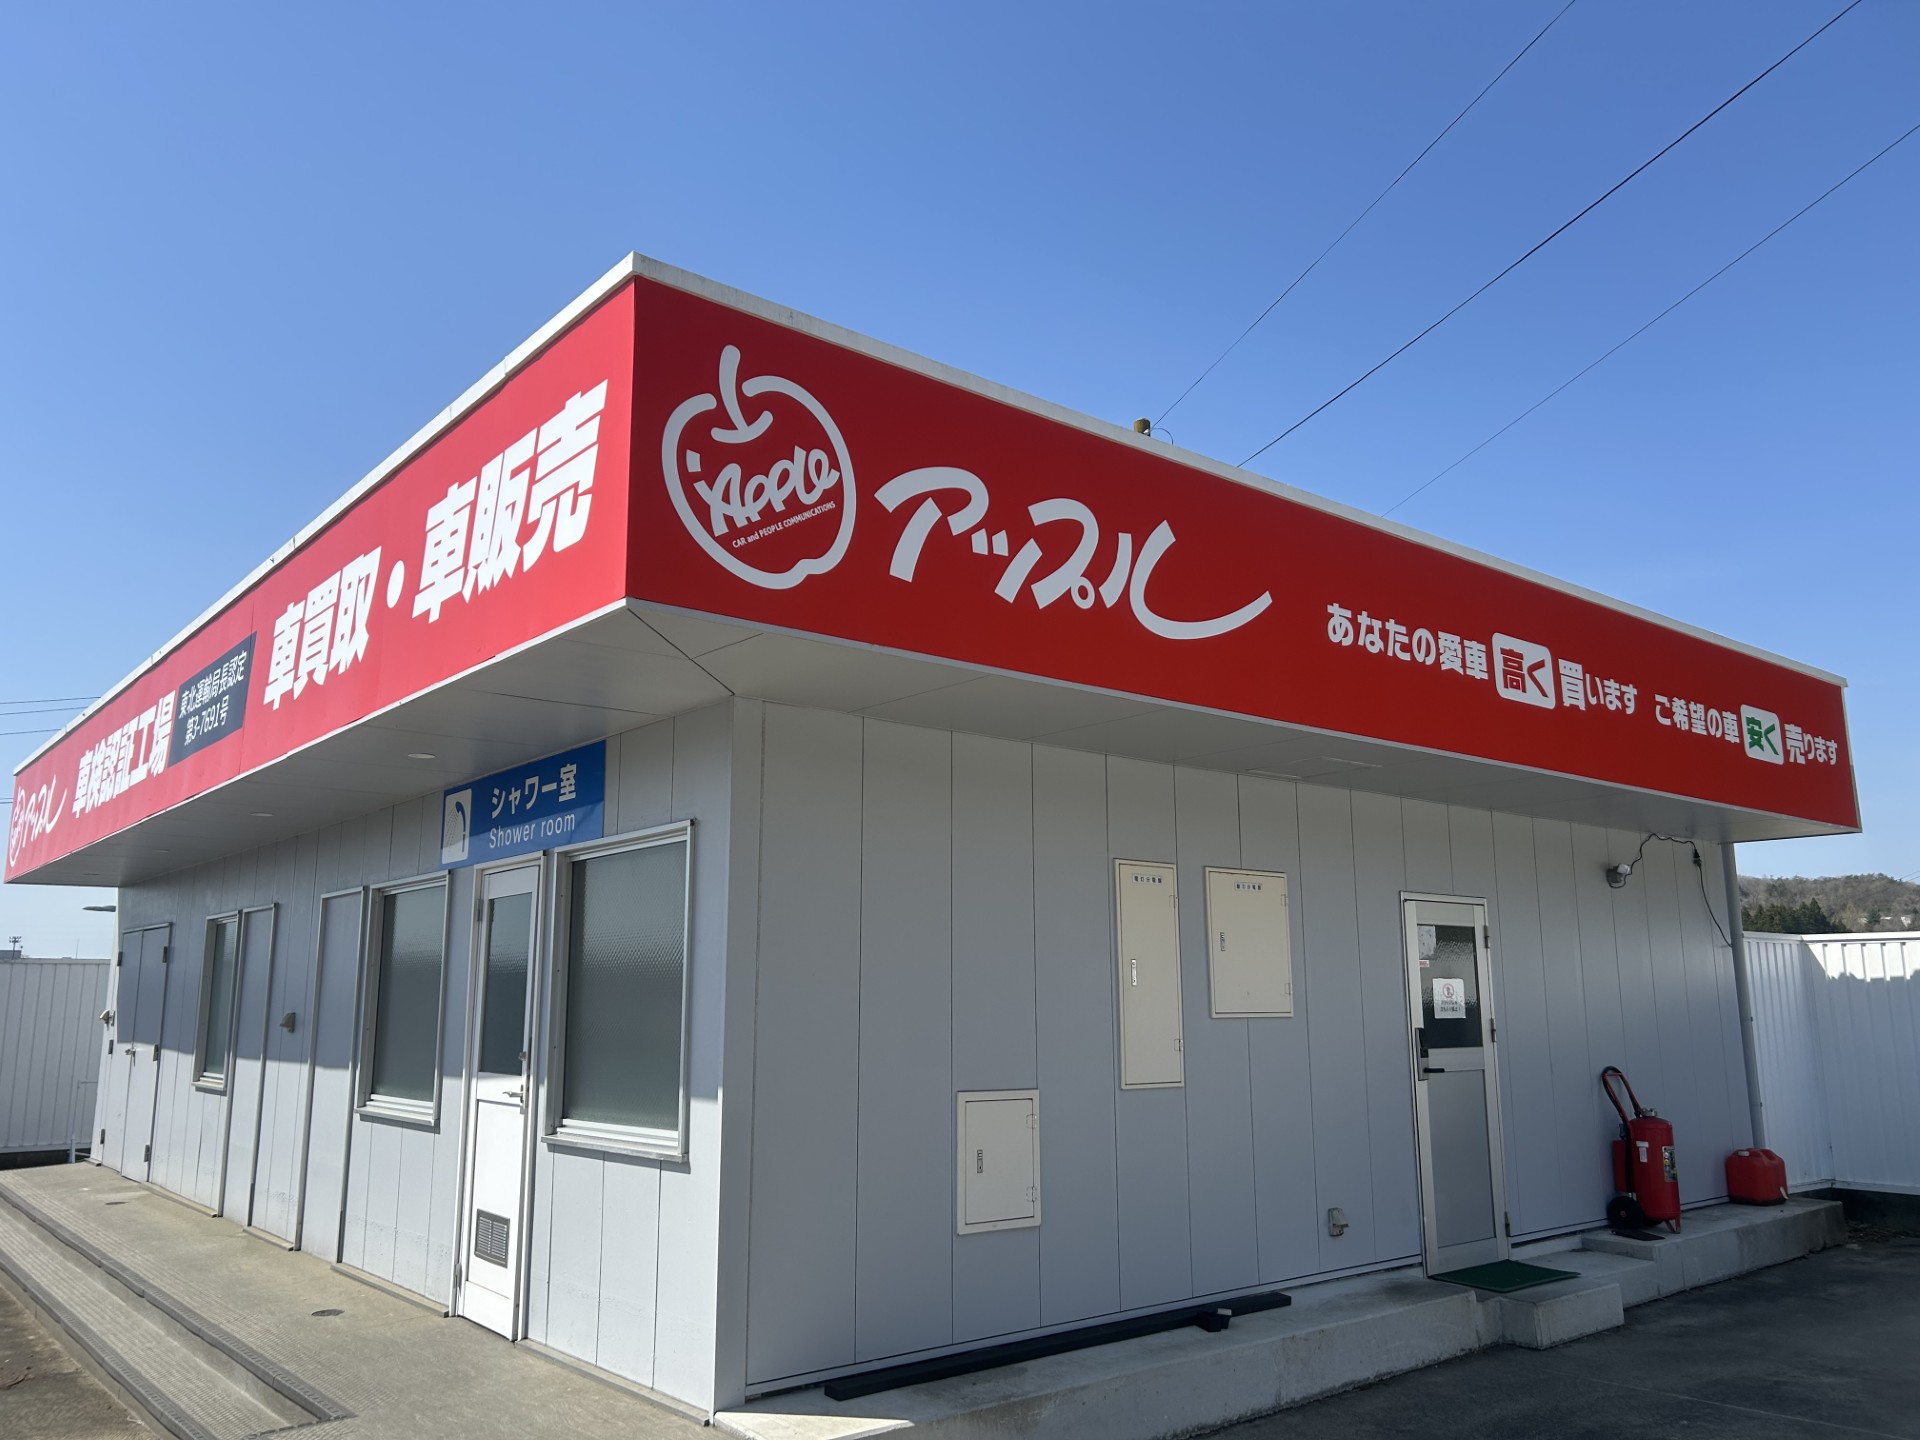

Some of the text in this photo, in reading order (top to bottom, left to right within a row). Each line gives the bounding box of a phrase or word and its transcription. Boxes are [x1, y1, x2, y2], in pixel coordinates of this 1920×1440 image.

[693, 445, 840, 536] Apple
[732, 500, 836, 548] CAR and PEOPLE COMMUNICATIONS
[263, 379, 608, 710] 車買取・車販売
[874, 466, 1272, 639] アップル
[72, 690, 175, 818] 車検認証工場
[491, 763, 577, 819] シャワー室
[489, 813, 575, 849] Shower room
